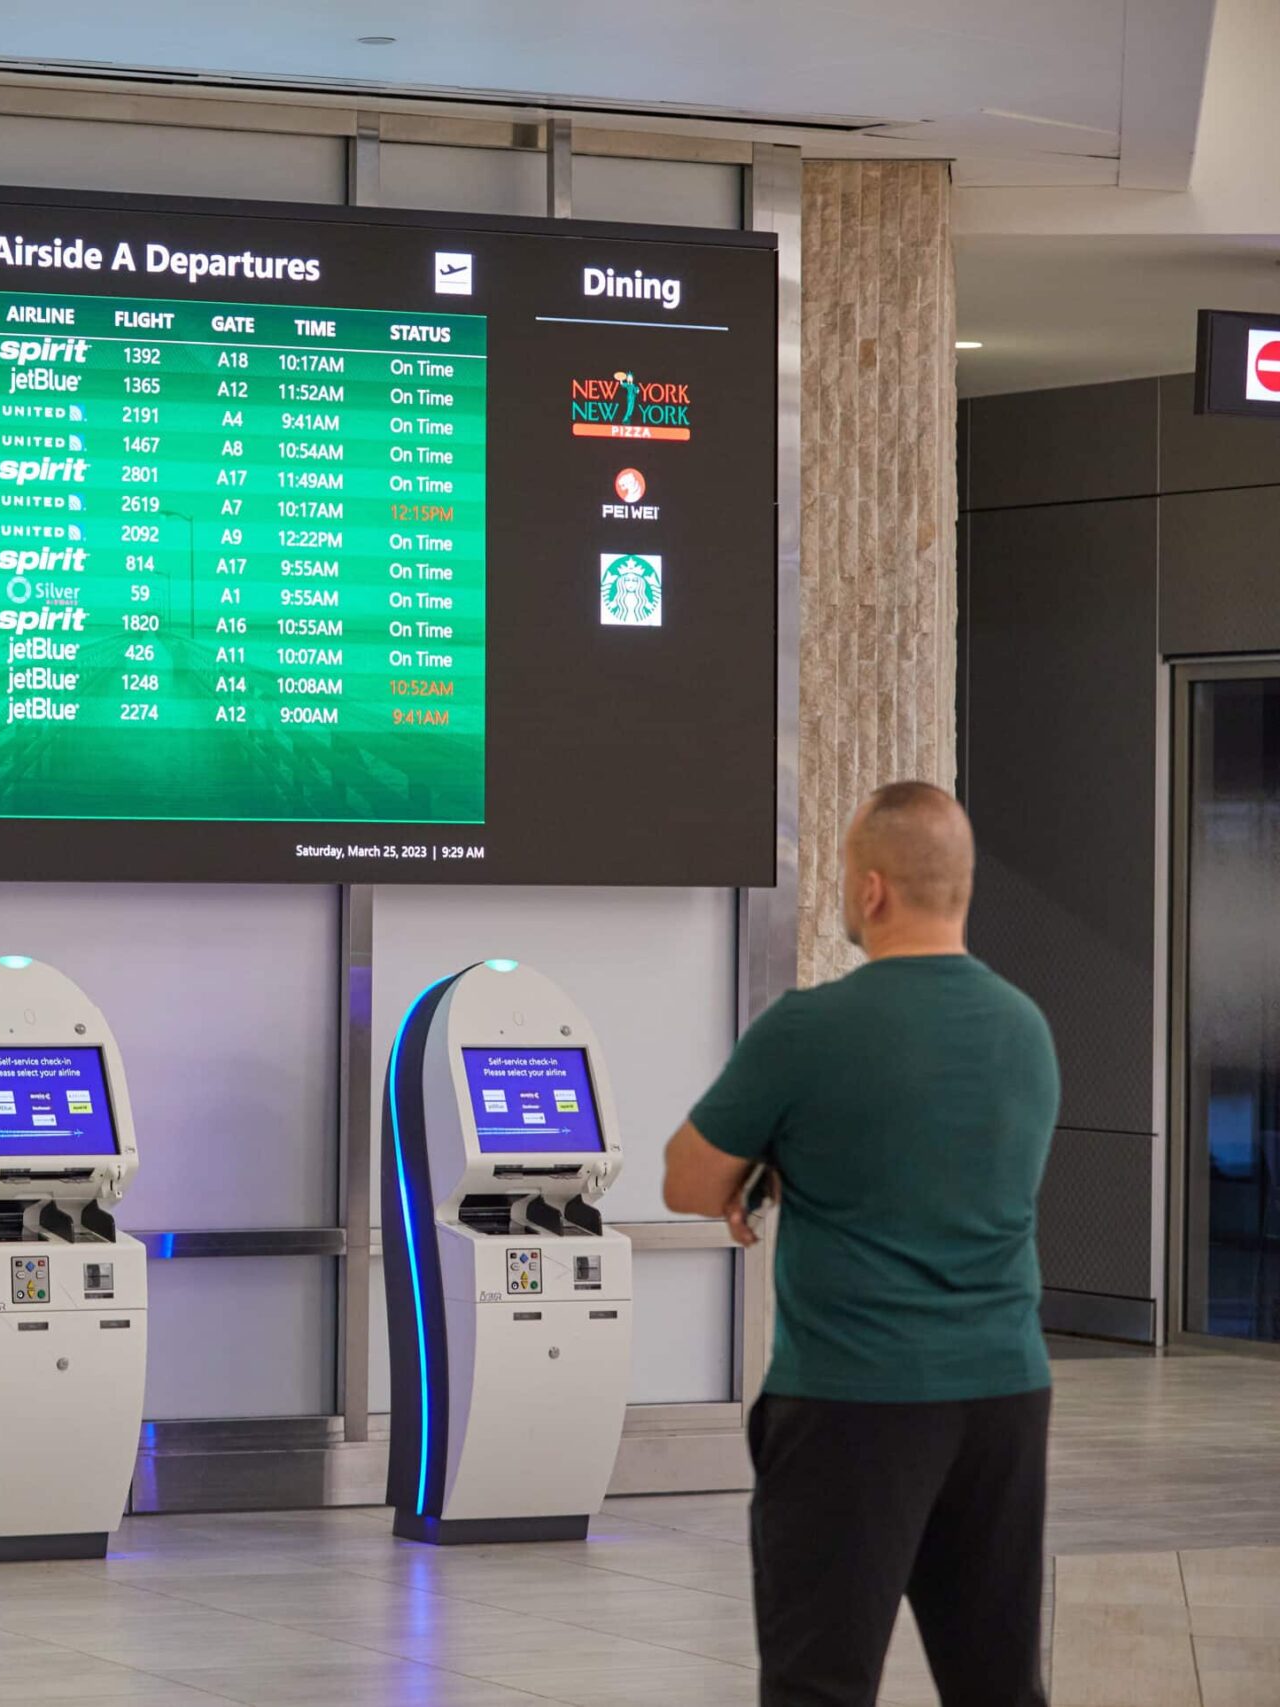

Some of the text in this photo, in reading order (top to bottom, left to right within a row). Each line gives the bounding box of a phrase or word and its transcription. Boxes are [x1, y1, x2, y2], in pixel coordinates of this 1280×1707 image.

[111, 242, 136, 271] A
[147, 244, 320, 283] Departures
[584, 269, 681, 309] Dining
[6, 305, 75, 325] AIRLINE
[115, 311, 175, 329] FLIGHT
[211, 316, 255, 333] GATE
[294, 319, 336, 337] TIME
[390, 325, 451, 343] STATUS
[124, 347, 160, 364] 1392
[218, 351, 248, 368] A18
[279, 354, 344, 372] 10:17AM
[390, 359, 413, 375] On
[417, 360, 454, 377] Time
[9, 367, 81, 394] jetBlue
[124, 377, 160, 394] 1365
[217, 381, 248, 398] A12
[279, 384, 344, 402] 11:52AM
[390, 388, 413, 404] On
[417, 389, 454, 406] Time
[572, 379, 690, 403] NEW YORK
[2, 405, 66, 418] UNITED
[122, 406, 158, 423] 2191
[222, 411, 243, 427] A4
[282, 413, 339, 431] 9:41AM
[390, 417, 413, 433] On
[416, 418, 453, 435] Time
[572, 401, 690, 425] NEW YORK
[611, 426, 651, 437] PIZZA
[2, 435, 65, 448] UNITED
[123, 436, 160, 453] 1467
[222, 440, 243, 456] A8
[279, 442, 343, 460] 10:54AM
[390, 446, 413, 462] On
[416, 447, 453, 464] Time
[121, 465, 158, 482] 2801
[216, 469, 247, 486] A17
[278, 472, 343, 489] 11:49AM
[389, 475, 413, 492] On
[416, 476, 453, 493] Time
[1, 495, 65, 508] UNITED
[121, 495, 160, 512] 2619
[221, 499, 242, 515] A7
[278, 501, 343, 519] 10:17AM
[391, 504, 454, 522] 12:15PM
[602, 505, 658, 519] PEI WEI
[1, 525, 65, 538] UNITED
[121, 525, 159, 542] 2092
[221, 528, 242, 545] A9
[279, 530, 343, 548] 12:22PM
[389, 533, 412, 550] On
[416, 534, 453, 551] Time
[126, 555, 155, 571] 814
[216, 558, 247, 574] A17
[281, 560, 339, 577] 9:55AM
[389, 563, 412, 579] On
[416, 563, 453, 580] Time
[35, 582, 80, 599] Silver
[131, 585, 150, 601] 59
[221, 588, 240, 604] A1
[281, 589, 339, 606] 9:55AM
[389, 592, 412, 608] On
[416, 592, 453, 609] Time
[122, 615, 159, 631] 1820
[216, 617, 247, 634] A16
[277, 619, 343, 636] 10:55AM
[389, 621, 412, 637] On
[416, 621, 453, 638] Time
[7, 636, 79, 664] jetBlue
[125, 644, 154, 661] 426
[216, 647, 244, 663] A11
[277, 648, 343, 665] 10:07AM
[389, 650, 412, 666] On
[416, 651, 453, 667] Time
[7, 667, 79, 694] jetBlue
[122, 674, 159, 691] 1248
[216, 676, 246, 692] A14
[277, 677, 342, 694] 10:08AM
[390, 680, 454, 696] 10:52AM
[7, 696, 79, 724] jetBlue
[120, 704, 159, 720] 2274
[215, 706, 246, 722] A12
[280, 707, 338, 723] 9:00AM
[392, 708, 449, 725] 9:41AM
[296, 845, 344, 859] Saturday,
[348, 846, 380, 857] March
[383, 846, 399, 858] 25,
[402, 846, 427, 858] 2023
[442, 846, 463, 858] 9:29
[466, 847, 484, 858] AM
[17, 1069, 38, 1077] select
[41, 1057, 71, 1066] check-in
[488, 1057, 557, 1066] Self-service check-in
